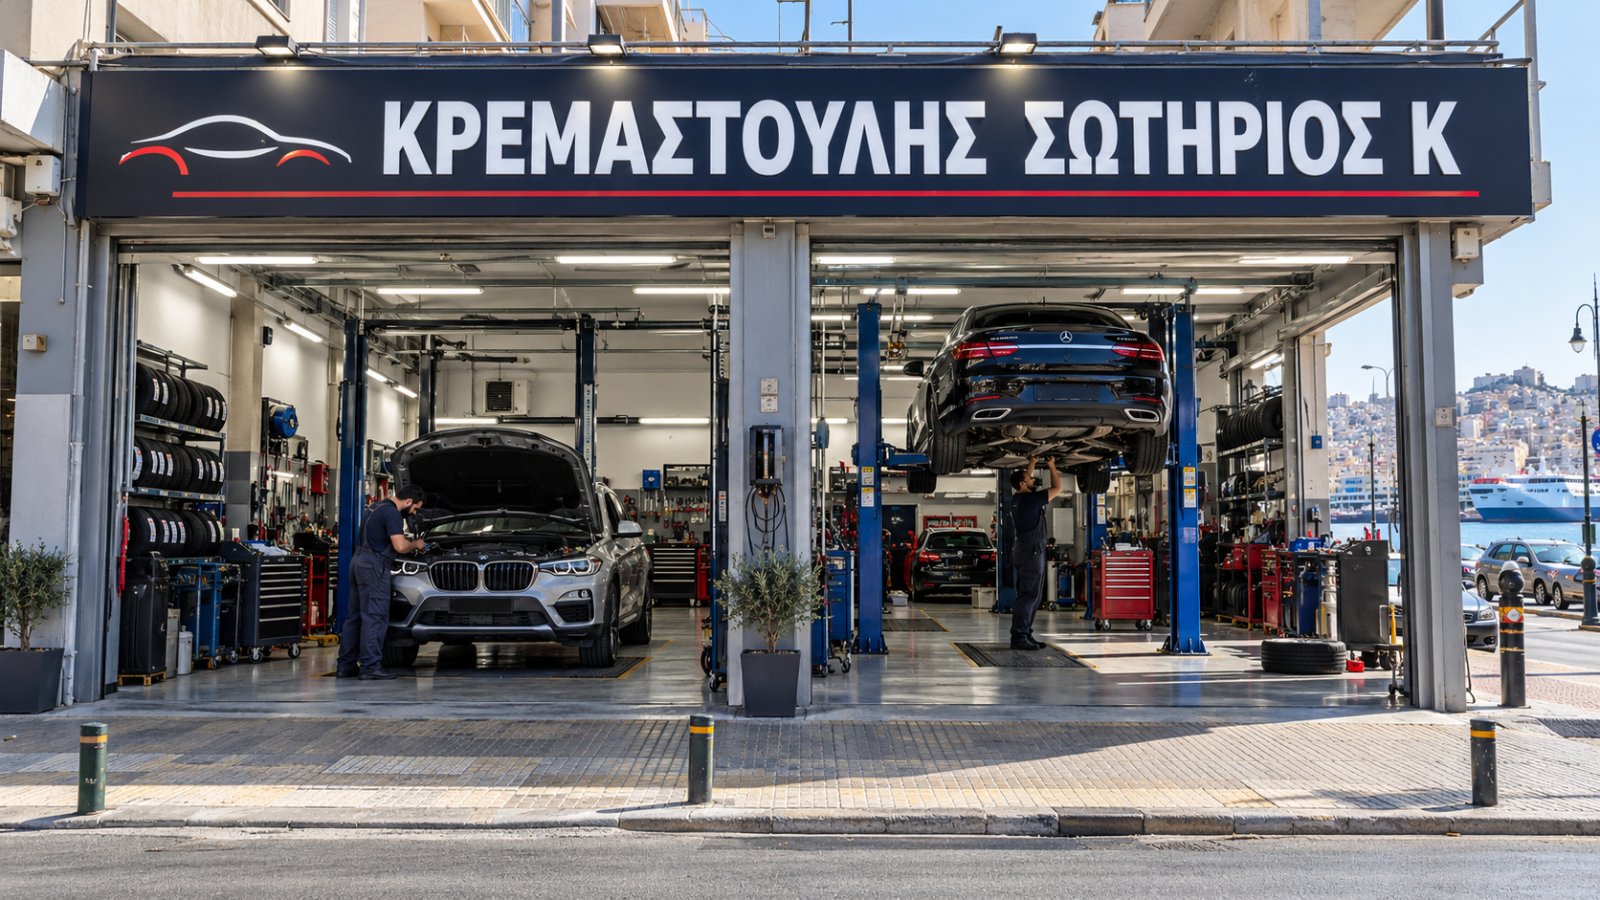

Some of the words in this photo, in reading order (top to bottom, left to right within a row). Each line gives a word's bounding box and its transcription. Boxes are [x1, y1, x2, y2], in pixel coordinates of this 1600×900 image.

[383, 100, 987, 176] ΚΡΕΜΑΣΤΟΥΛΗΣ
[1024, 100, 1384, 176] ΣΩΤΗΡΙΟΣ
[1411, 101, 1462, 175] Κ
